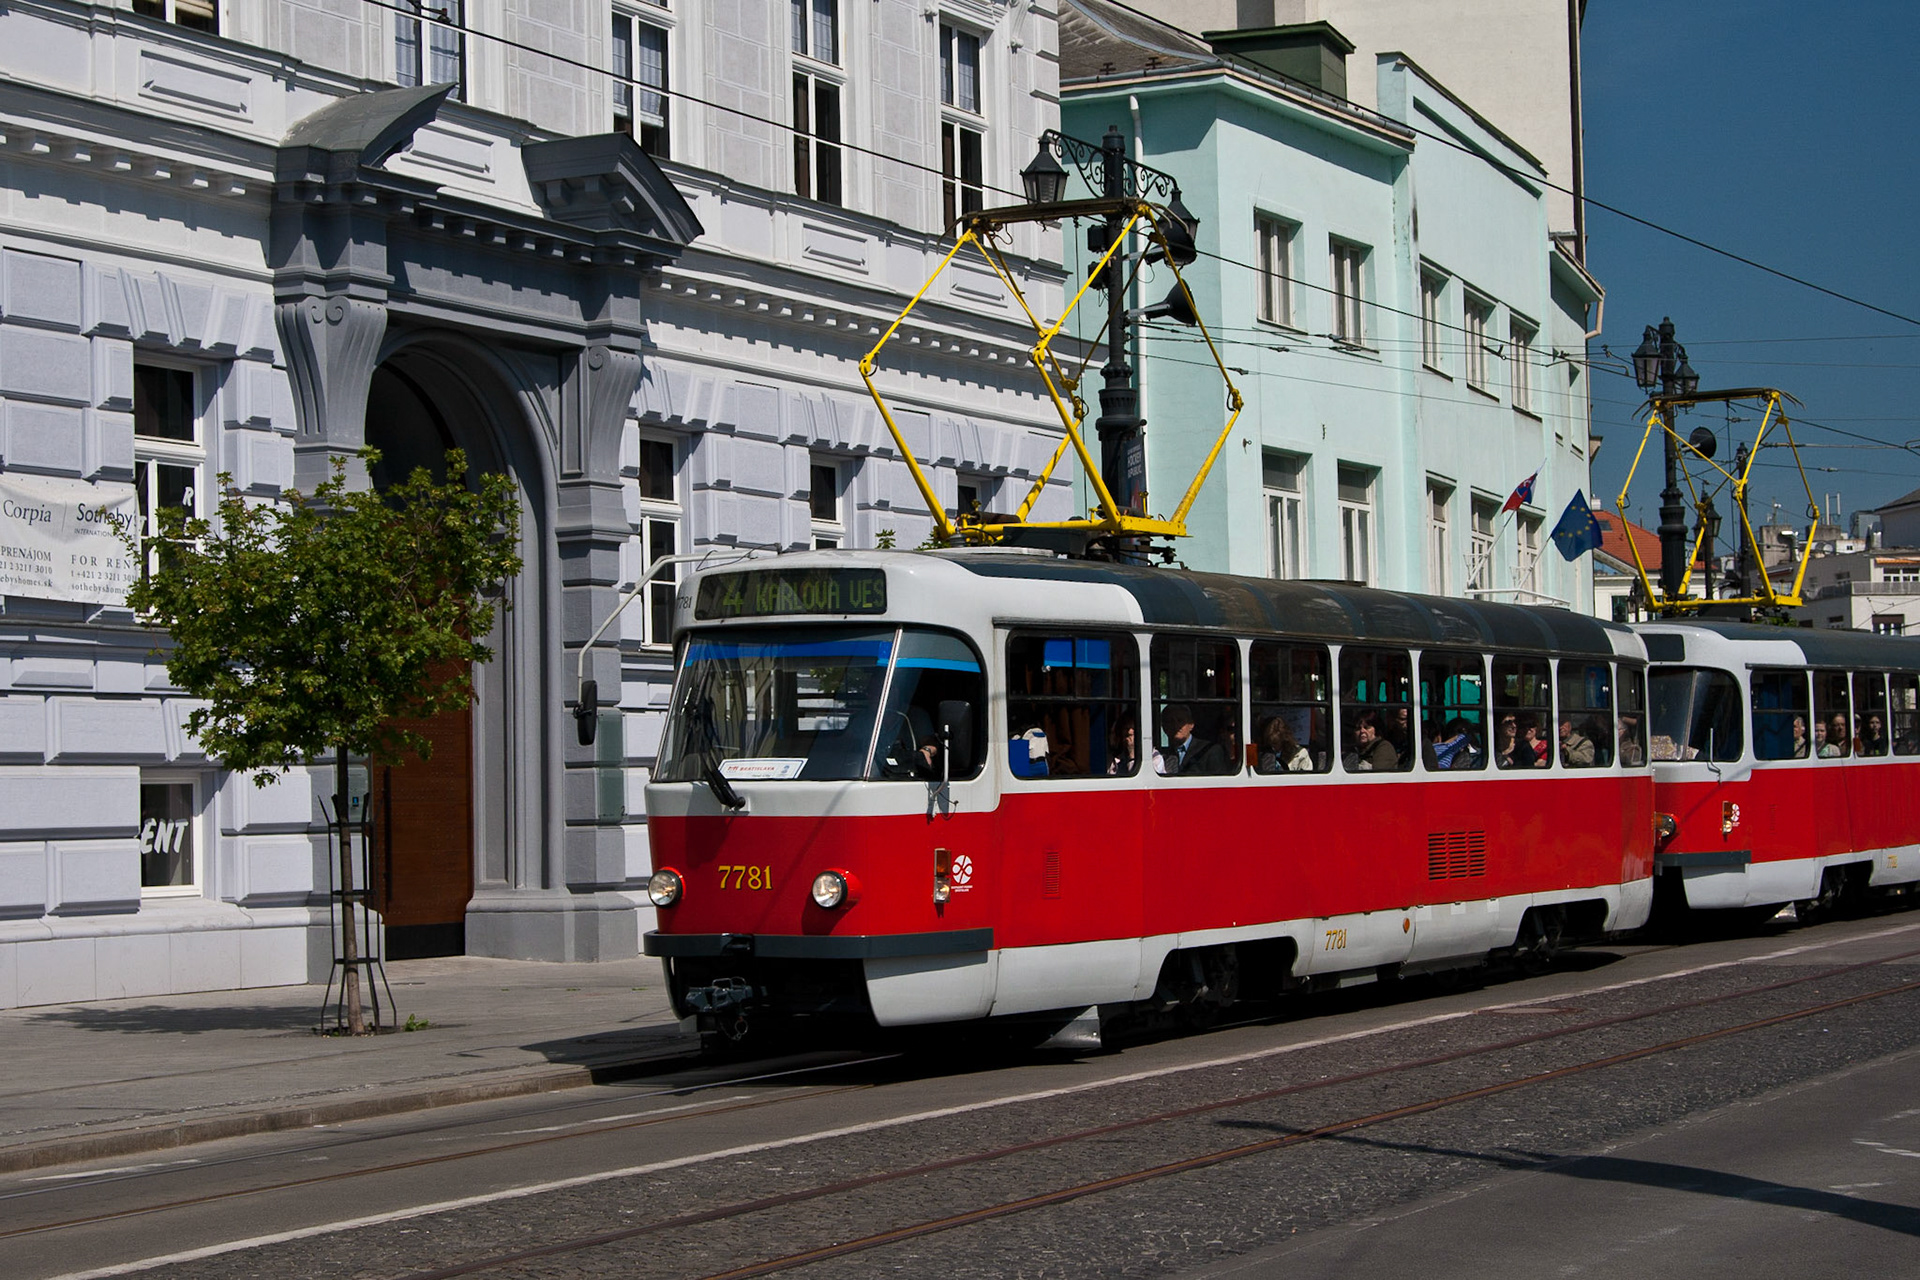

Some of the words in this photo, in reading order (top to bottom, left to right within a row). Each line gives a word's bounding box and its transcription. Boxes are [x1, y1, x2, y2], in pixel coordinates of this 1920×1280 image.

[3, 499, 52, 526] Corpia
[76, 502, 136, 532] Sotheby
[74, 527, 113, 538] INTERNATION
[1, 546, 52, 562] PRENÁJOM
[71, 554, 98, 567] FOR
[722, 583, 743, 614] 4
[756, 581, 840, 612] KARLOVA
[850, 578, 885, 609] VES
[718, 865, 773, 890] 7781
[1325, 928, 1347, 951] 7781
